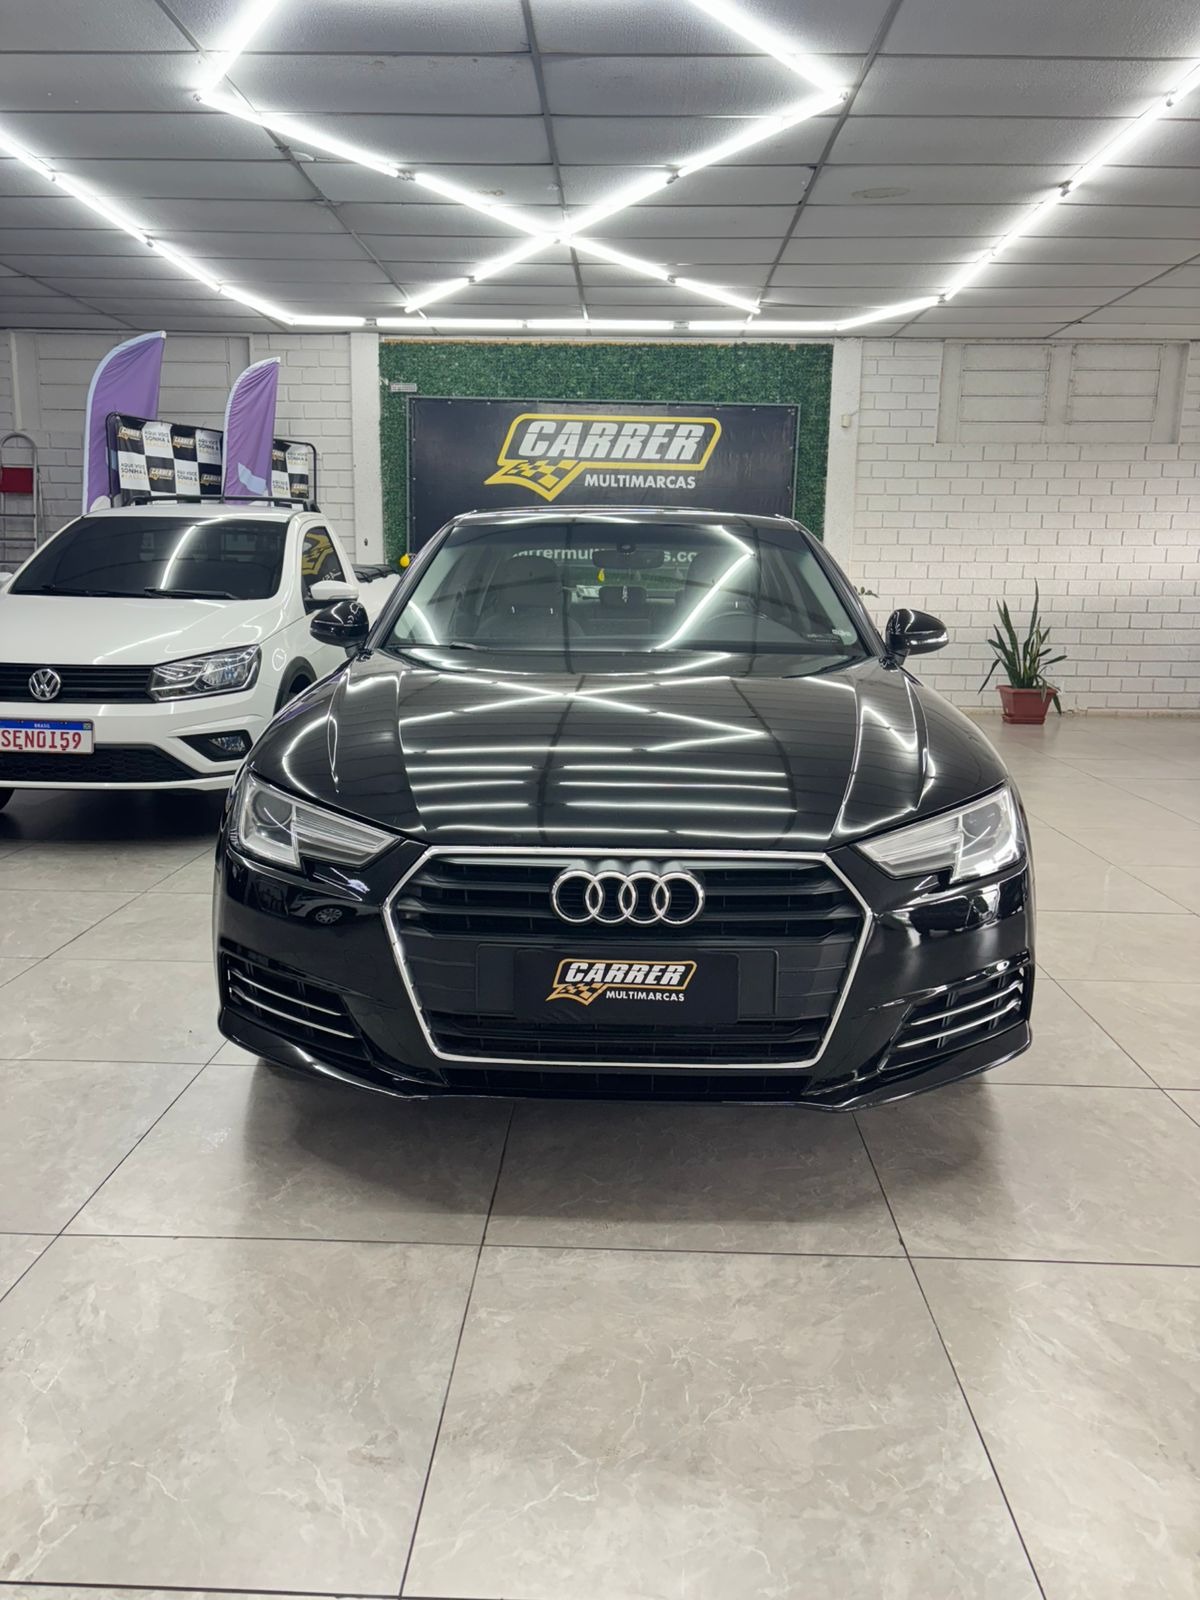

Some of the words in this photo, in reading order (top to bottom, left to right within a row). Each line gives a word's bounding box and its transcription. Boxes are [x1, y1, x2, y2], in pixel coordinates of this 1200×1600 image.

[518, 421, 705, 460] CARRER
[584, 473, 696, 489] MULTIMARCAS
[565, 962, 686, 985] CARRER
[606, 990, 685, 1002] MULTIMARCAS
